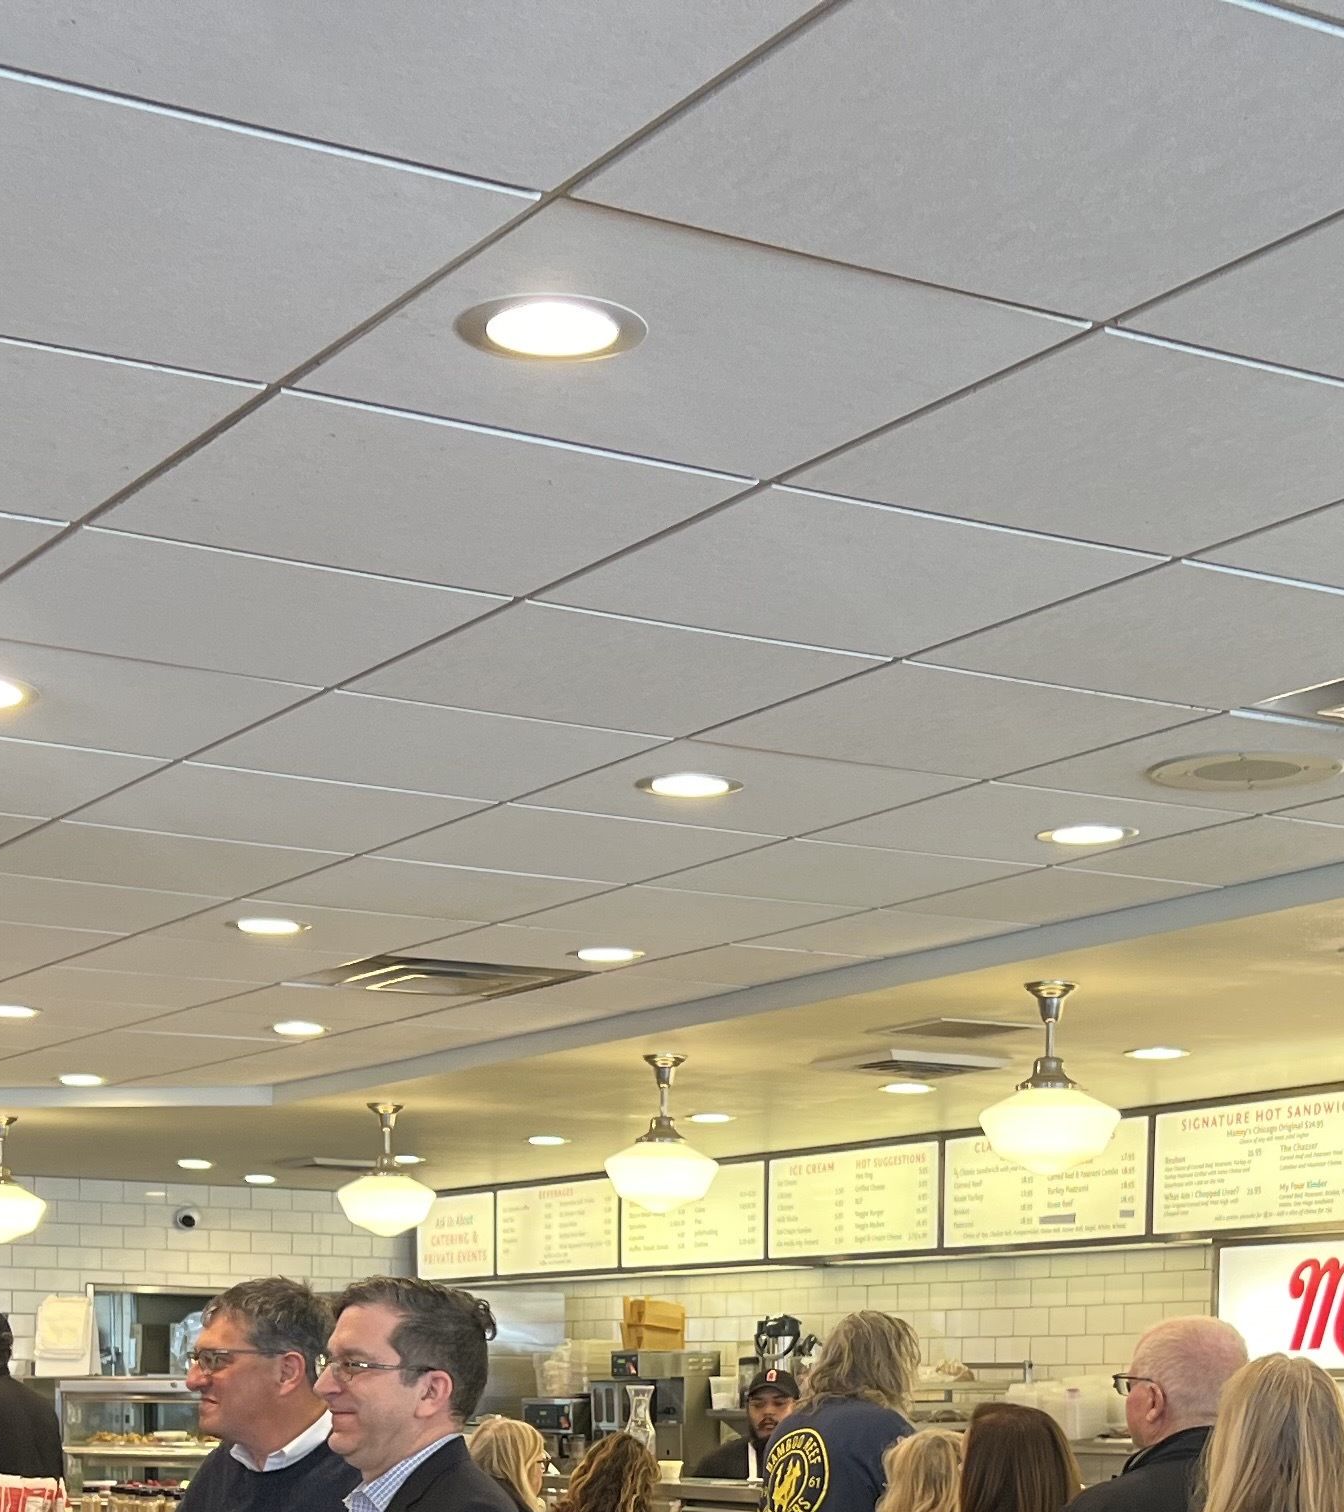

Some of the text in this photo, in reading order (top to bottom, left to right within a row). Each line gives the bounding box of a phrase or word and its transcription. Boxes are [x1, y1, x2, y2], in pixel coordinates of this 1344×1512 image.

[1180, 1111, 1250, 1133] SIGNATURE
[1255, 1107, 1282, 1123] HOT
[808, 1475, 822, 1489] 61
